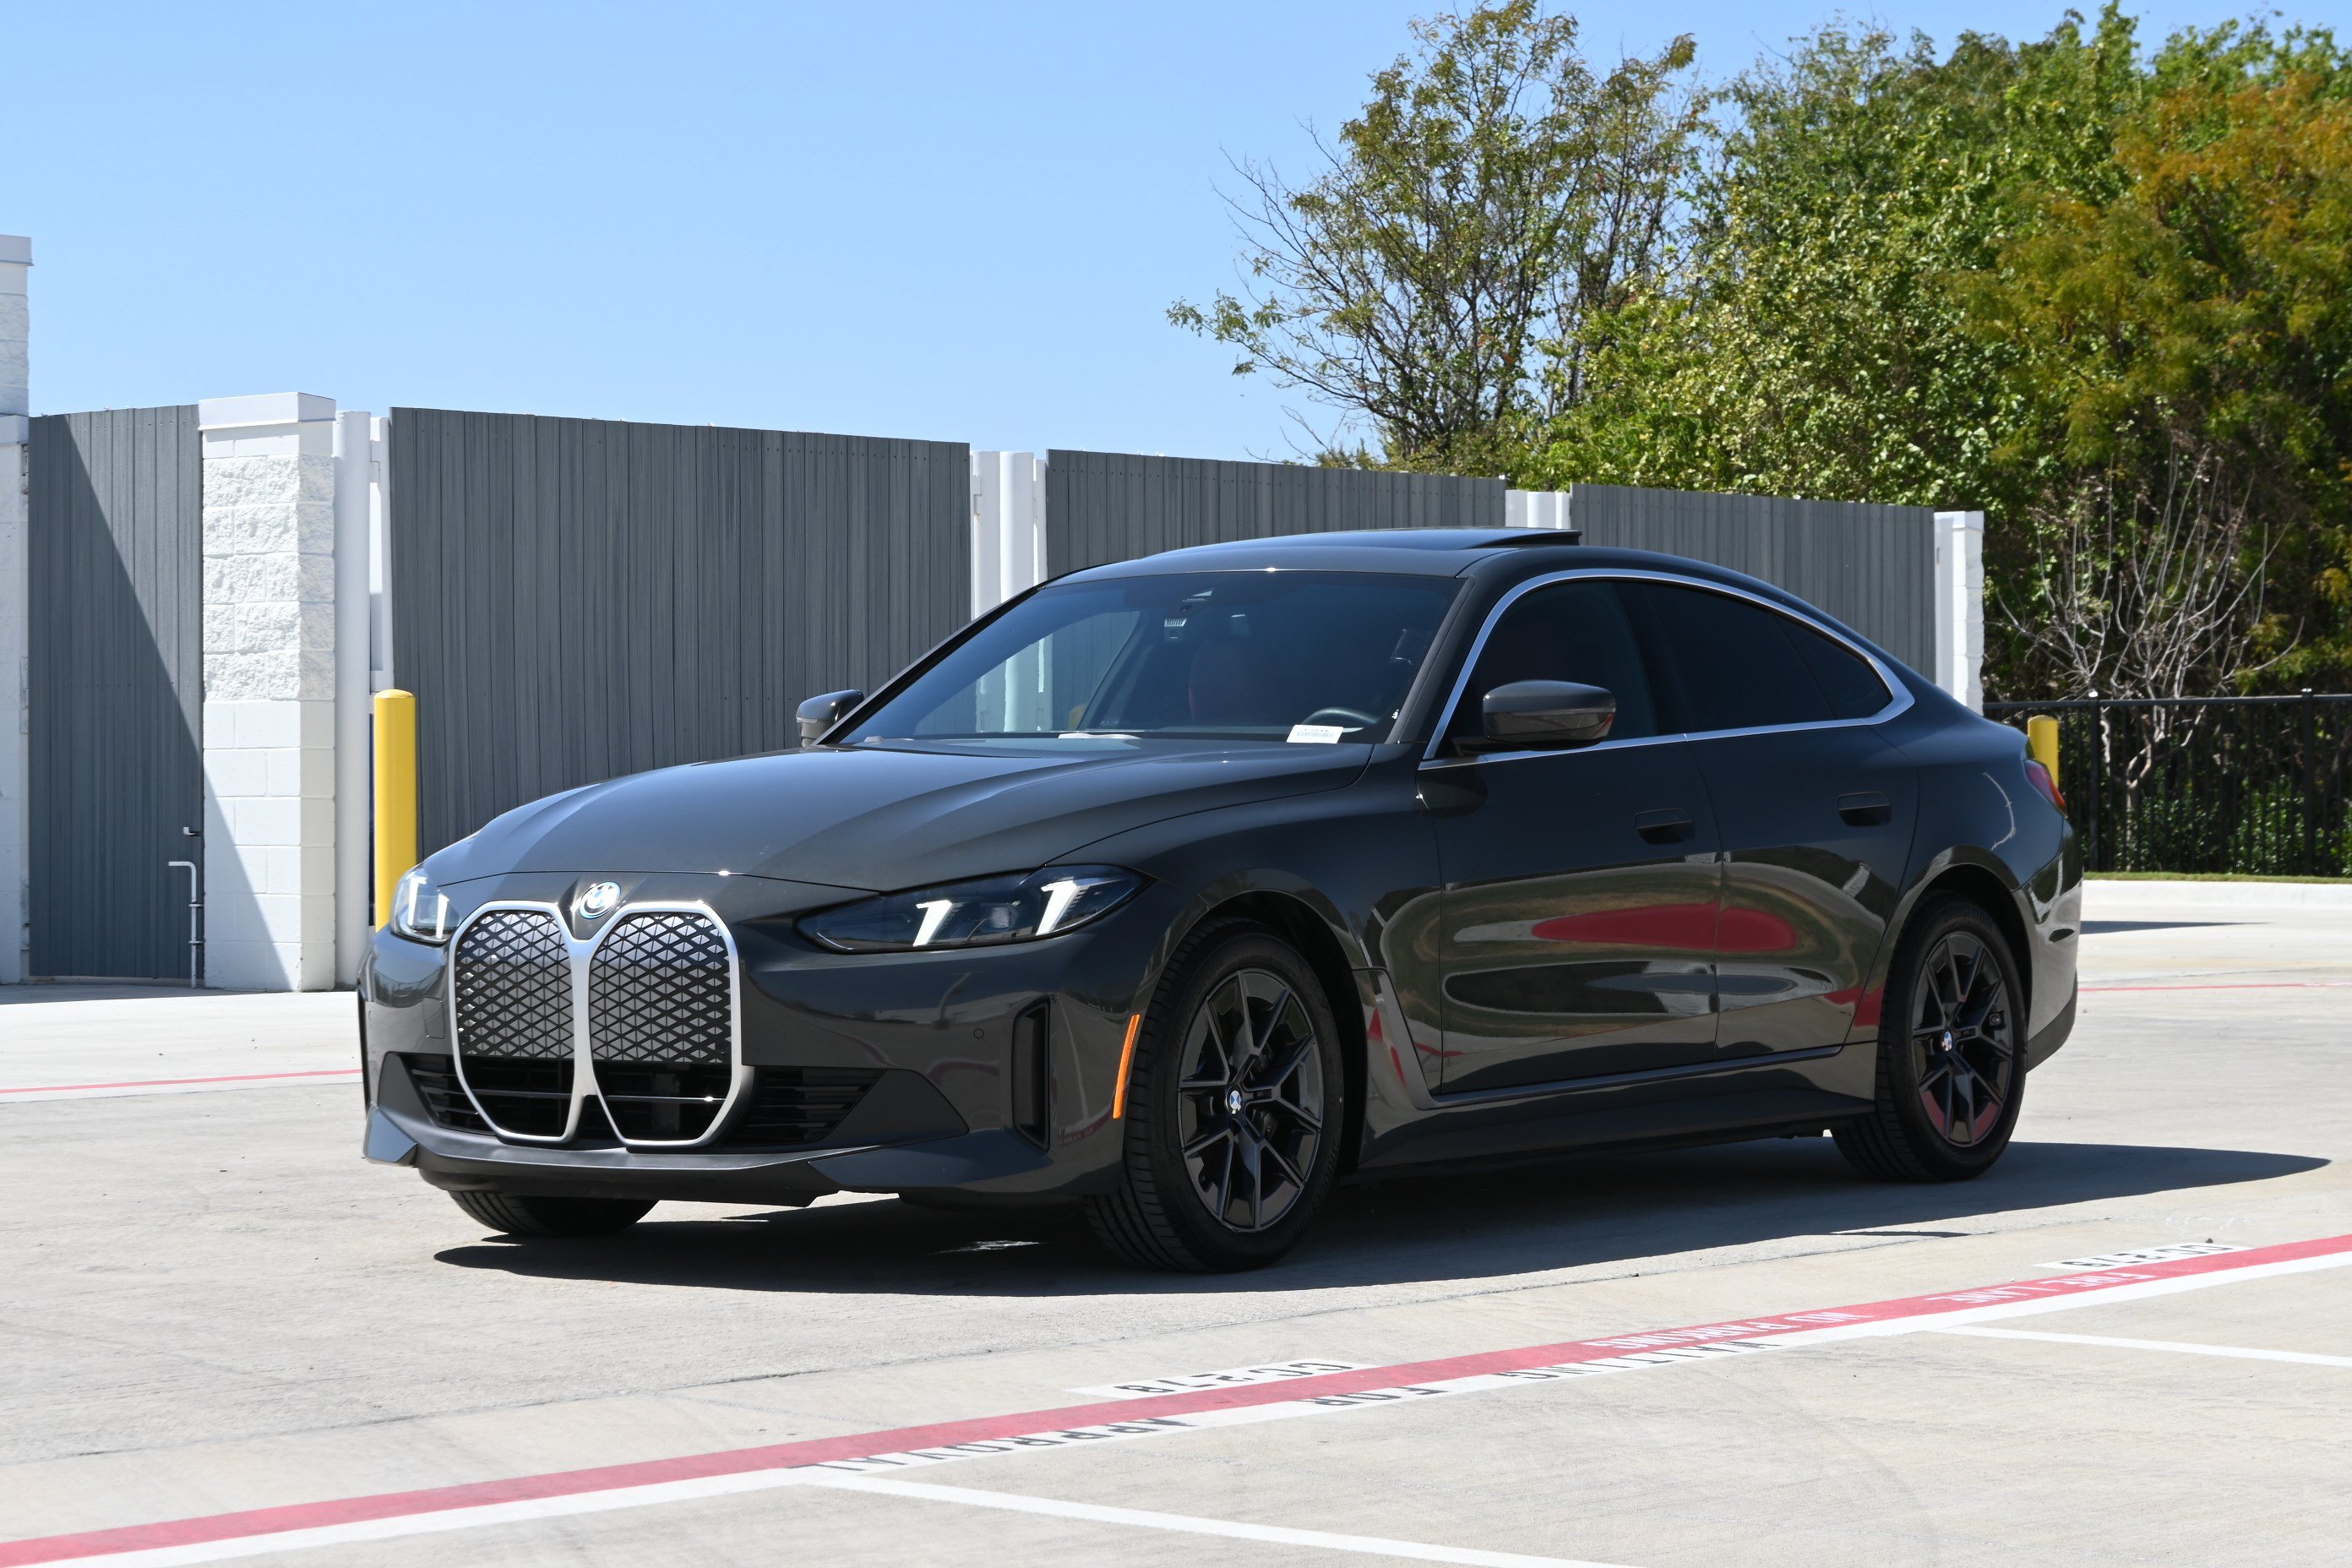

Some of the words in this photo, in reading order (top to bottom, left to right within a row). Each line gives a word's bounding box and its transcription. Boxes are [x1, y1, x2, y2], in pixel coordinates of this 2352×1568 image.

[2039, 1272, 2156, 1287] FIRE
[1924, 1286, 2061, 1303] LANE
[1783, 1312, 1874, 1323] NO
[1579, 1321, 1799, 1349] PARKING
[1493, 1341, 1783, 1379] WAITING
[1297, 1386, 1448, 1406] FOR
[786, 1418, 1196, 1471] APPROVAL
